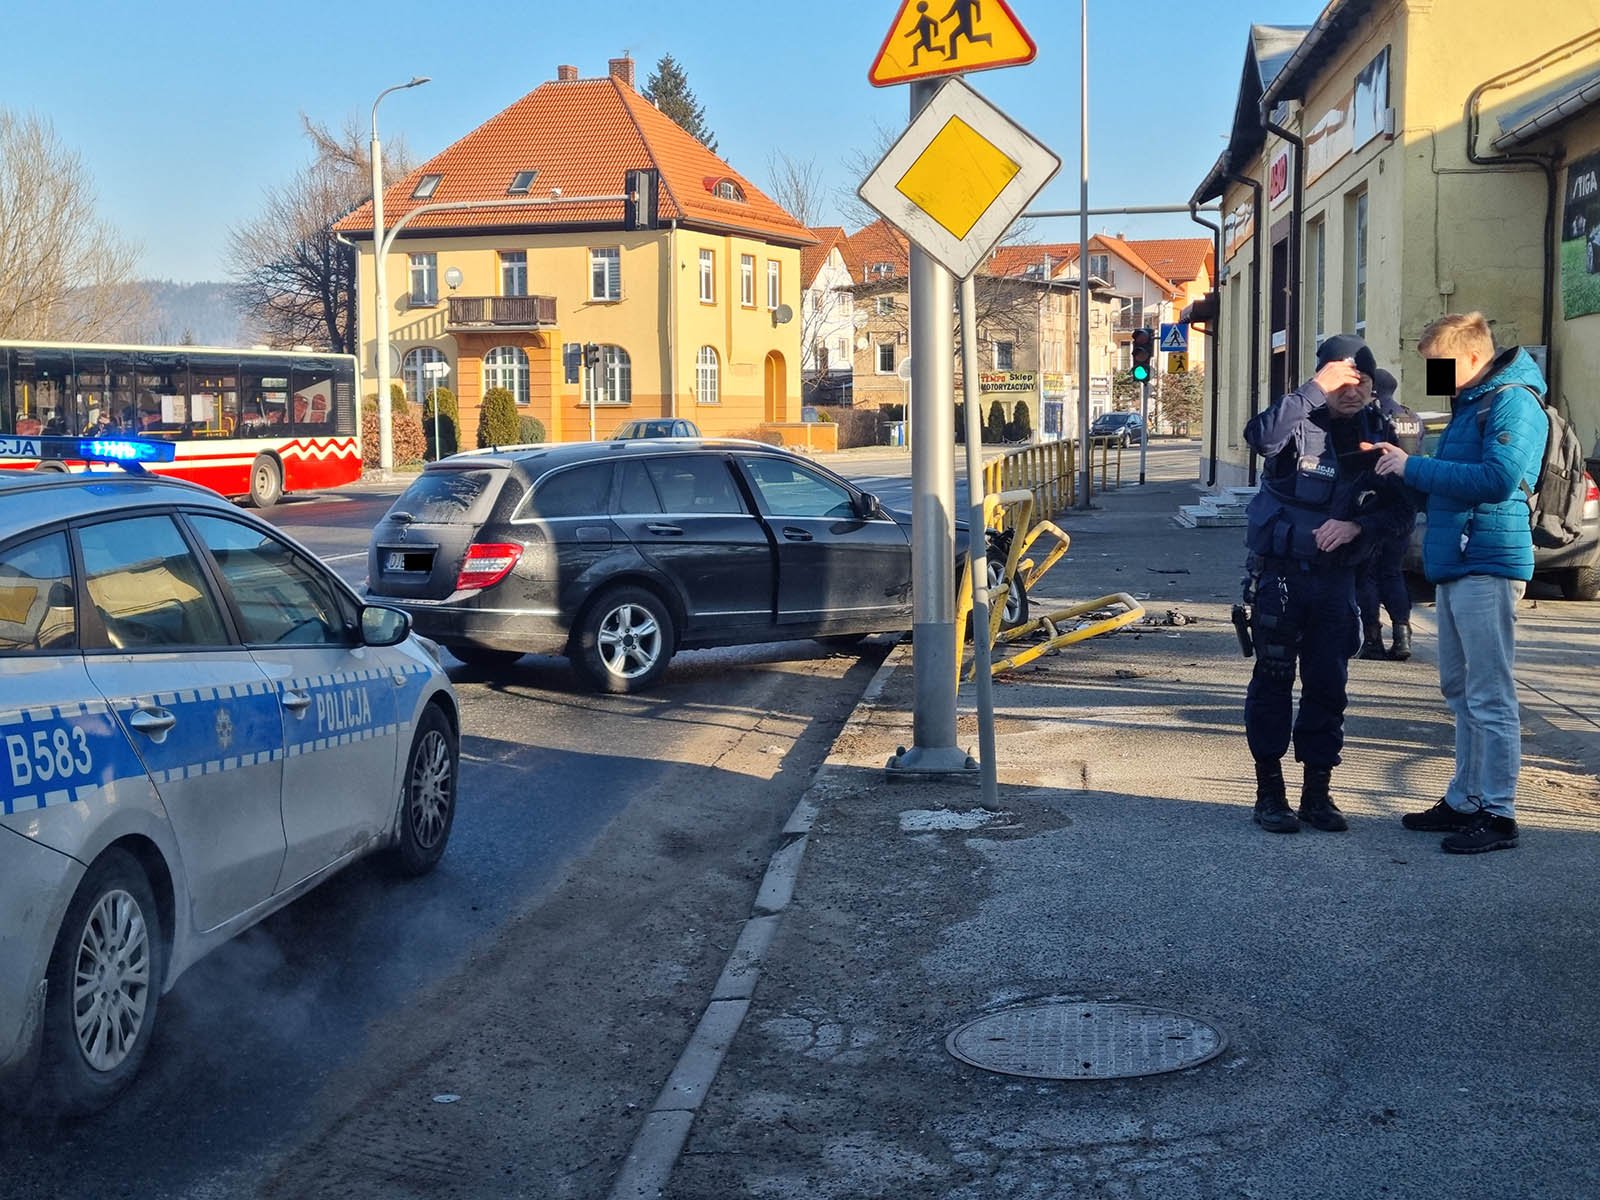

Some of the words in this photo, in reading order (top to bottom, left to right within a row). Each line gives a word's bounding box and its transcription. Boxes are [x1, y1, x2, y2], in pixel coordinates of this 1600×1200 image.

[980, 383, 1036, 391] MOTORYZACYJNY
[1009, 373, 1033, 382] Sklep
[315, 687, 372, 733] POLICJA
[6, 725, 93, 787] B583
